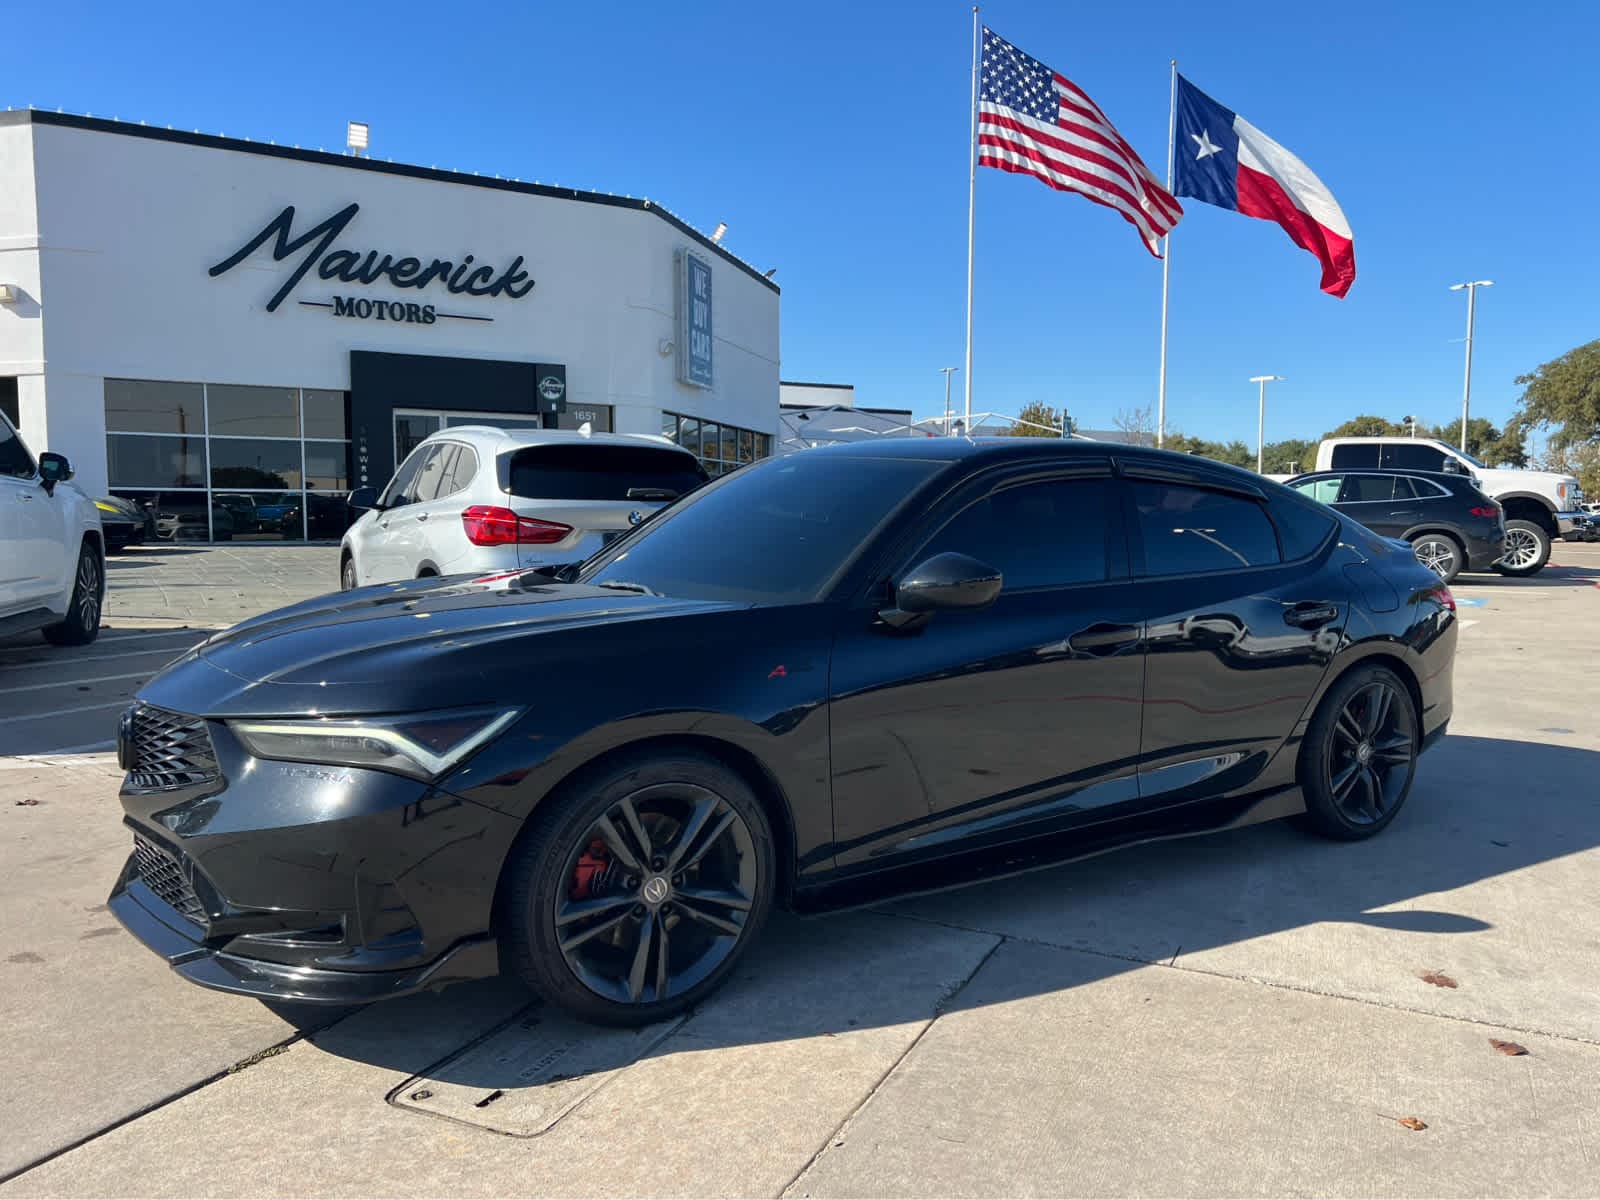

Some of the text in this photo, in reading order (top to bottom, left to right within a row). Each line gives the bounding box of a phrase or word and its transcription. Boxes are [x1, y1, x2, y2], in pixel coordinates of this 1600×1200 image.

[208, 202, 536, 312] Maverick
[694, 266, 707, 299] WE
[332, 296, 437, 325] MOTORS
